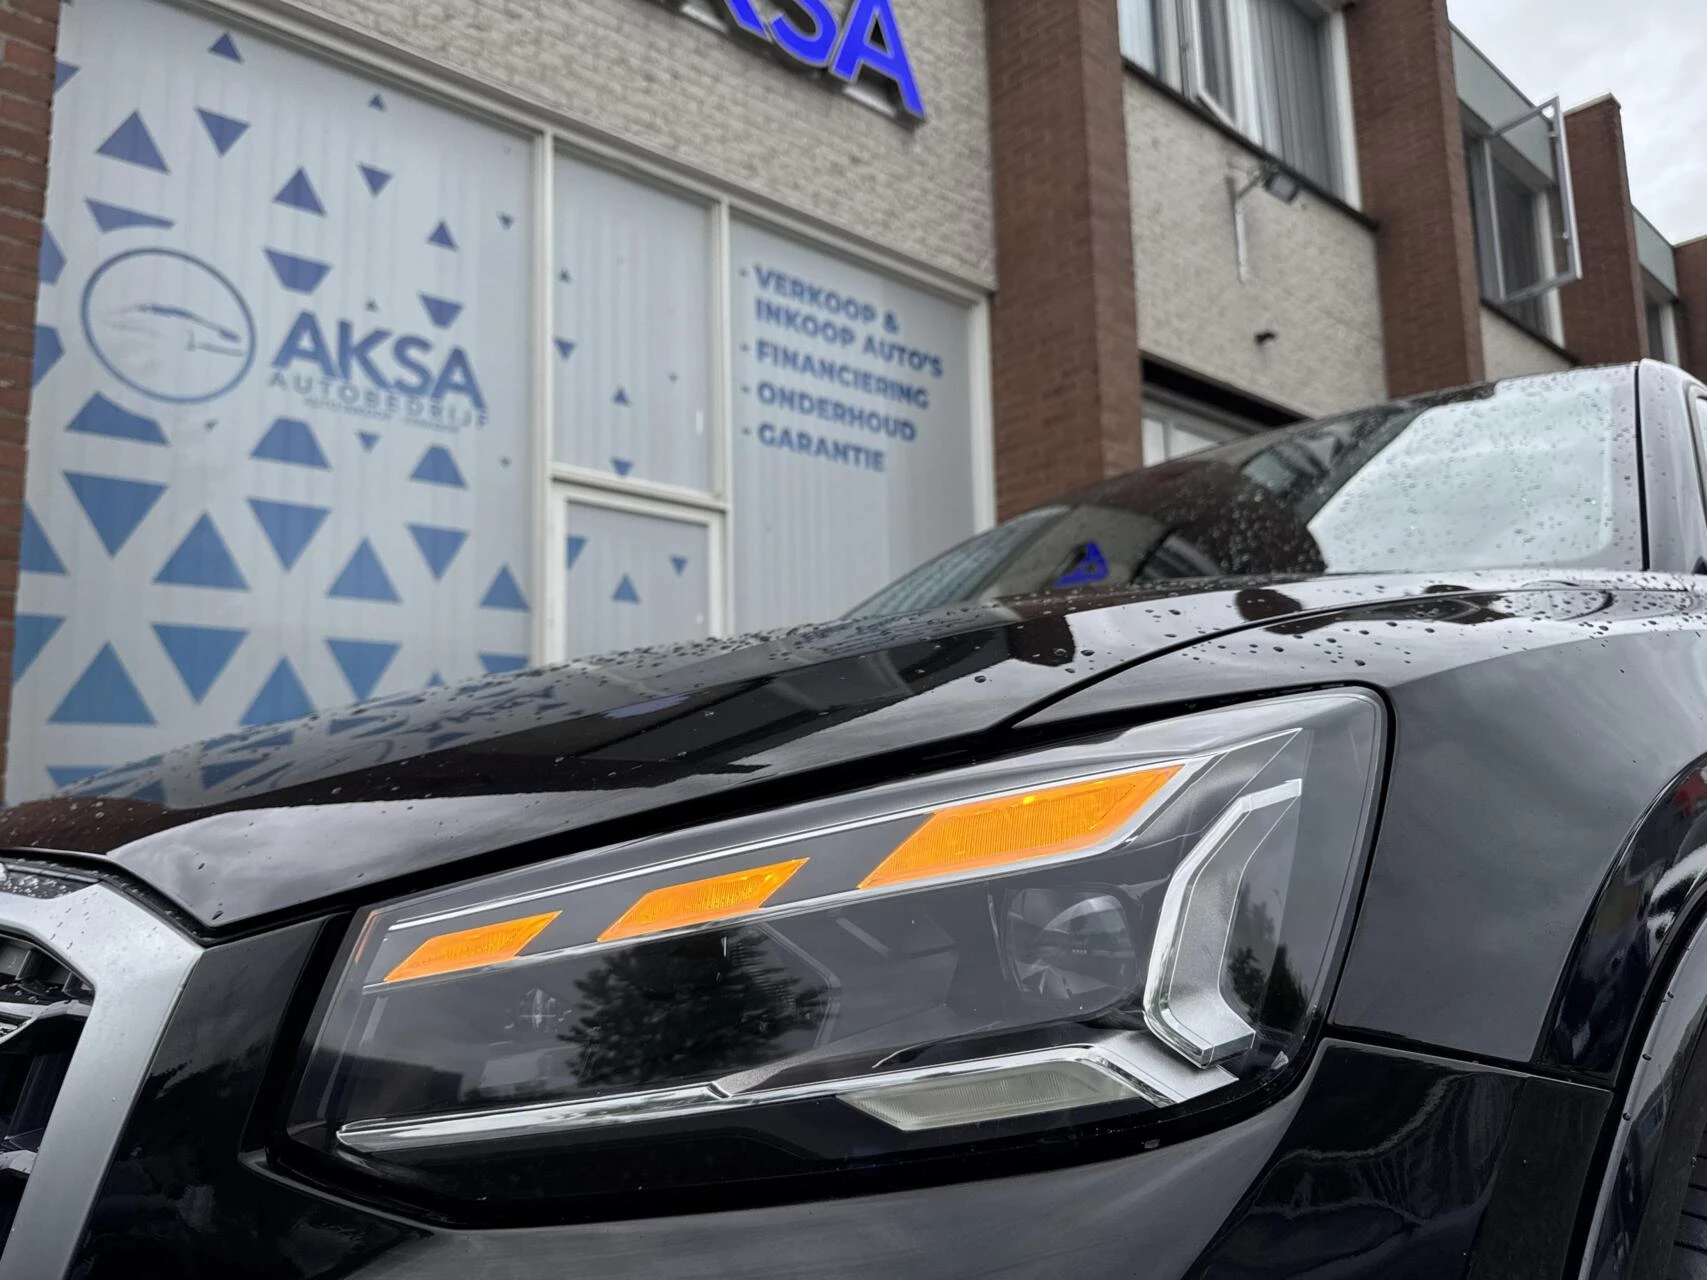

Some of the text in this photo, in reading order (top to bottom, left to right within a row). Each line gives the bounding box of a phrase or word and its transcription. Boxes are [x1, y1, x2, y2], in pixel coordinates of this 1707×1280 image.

[754, 264, 899, 334] VERKOOP &
[272, 311, 487, 412] AKSA
[755, 298, 944, 378] INKOOP AUTO'S
[268, 370, 489, 428] AUTOBEDRIJF
[756, 338, 930, 410] FINANCIERING
[757, 380, 917, 442] ONDERHOUD
[758, 422, 885, 472] GARANTIE
